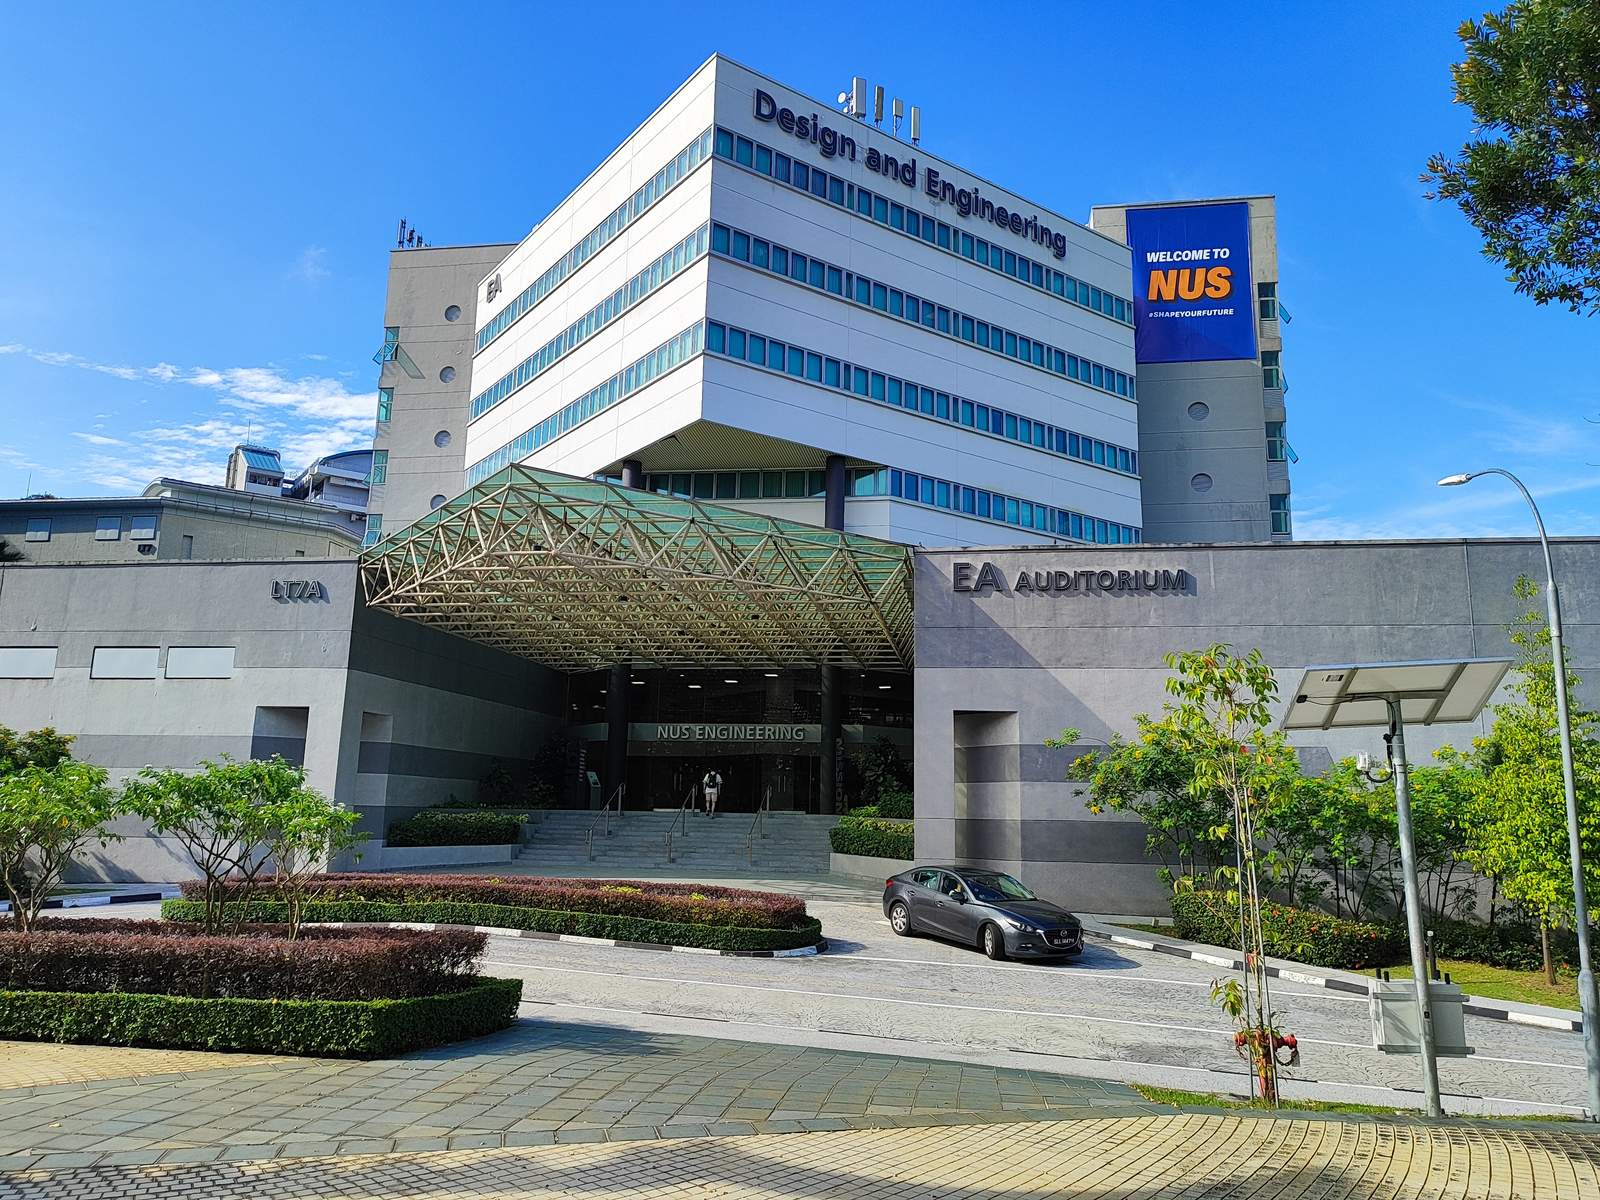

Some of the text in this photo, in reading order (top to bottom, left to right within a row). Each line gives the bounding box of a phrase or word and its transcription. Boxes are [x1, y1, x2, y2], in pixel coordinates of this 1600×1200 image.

[753, 87, 1068, 259] Design and Engineering
[1146, 248, 1230, 263] WELCOME TO
[487, 273, 503, 304] EA
[1148, 266, 1232, 301] NUS
[1148, 308, 1235, 318] #SHAPEYOURFUTURE
[270, 579, 322, 599] LT7A
[953, 561, 1188, 592] EA AUDITORIUM
[657, 725, 805, 740] NUS ENGINEERING
